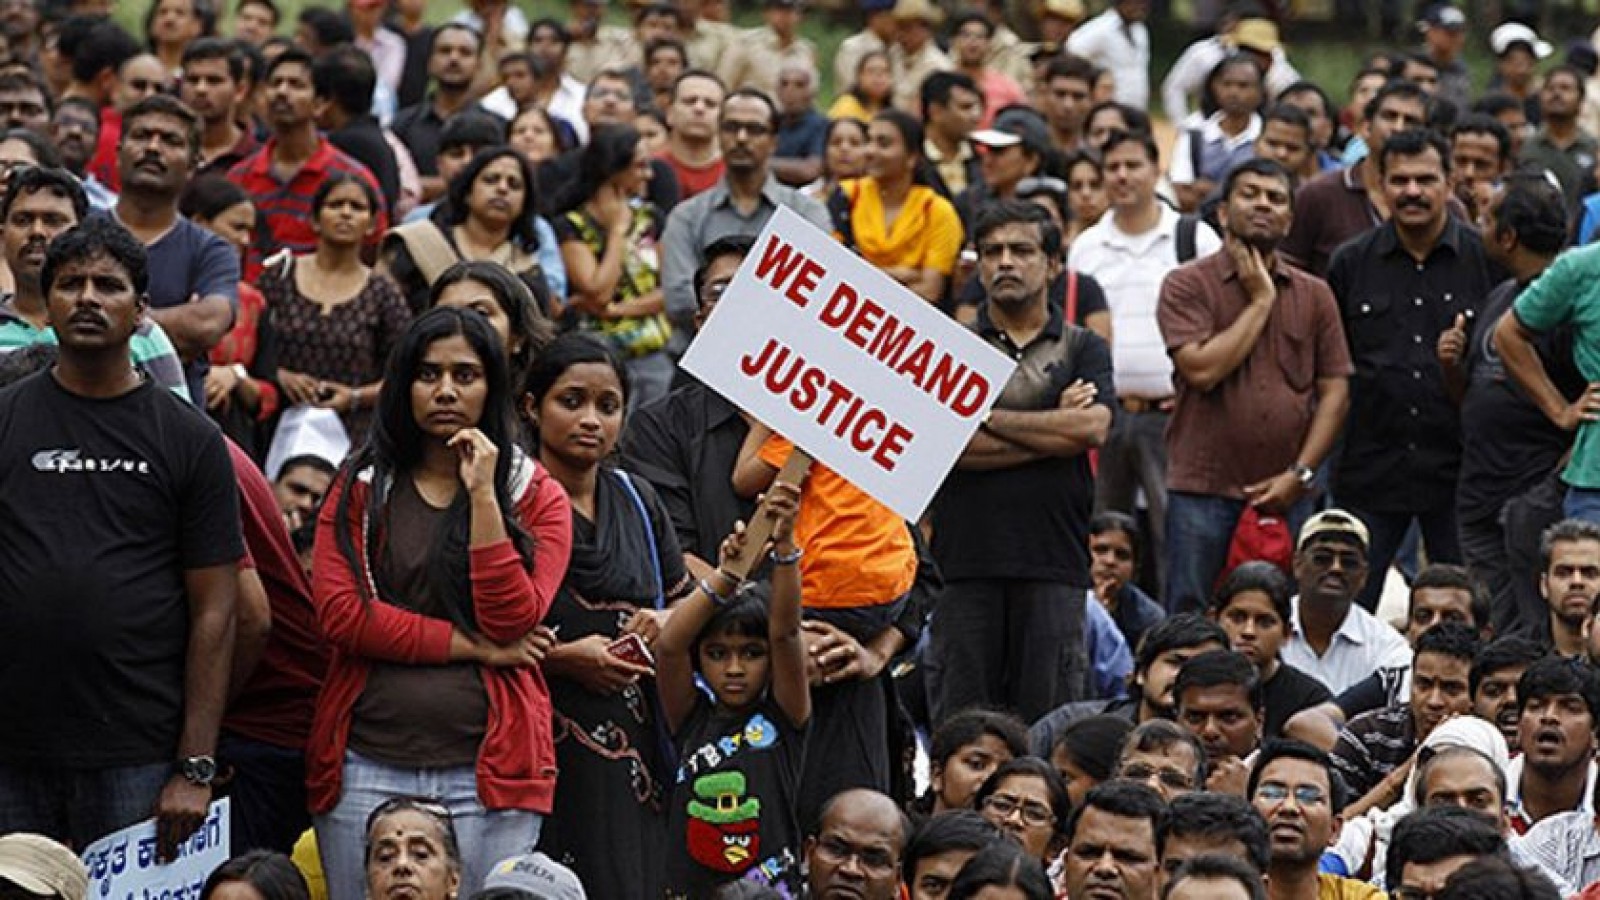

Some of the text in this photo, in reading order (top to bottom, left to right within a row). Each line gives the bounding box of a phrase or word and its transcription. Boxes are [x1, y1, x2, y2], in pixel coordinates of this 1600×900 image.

[740, 338, 914, 471] JUSTICE
[755, 235, 990, 418] WE DEMAND
